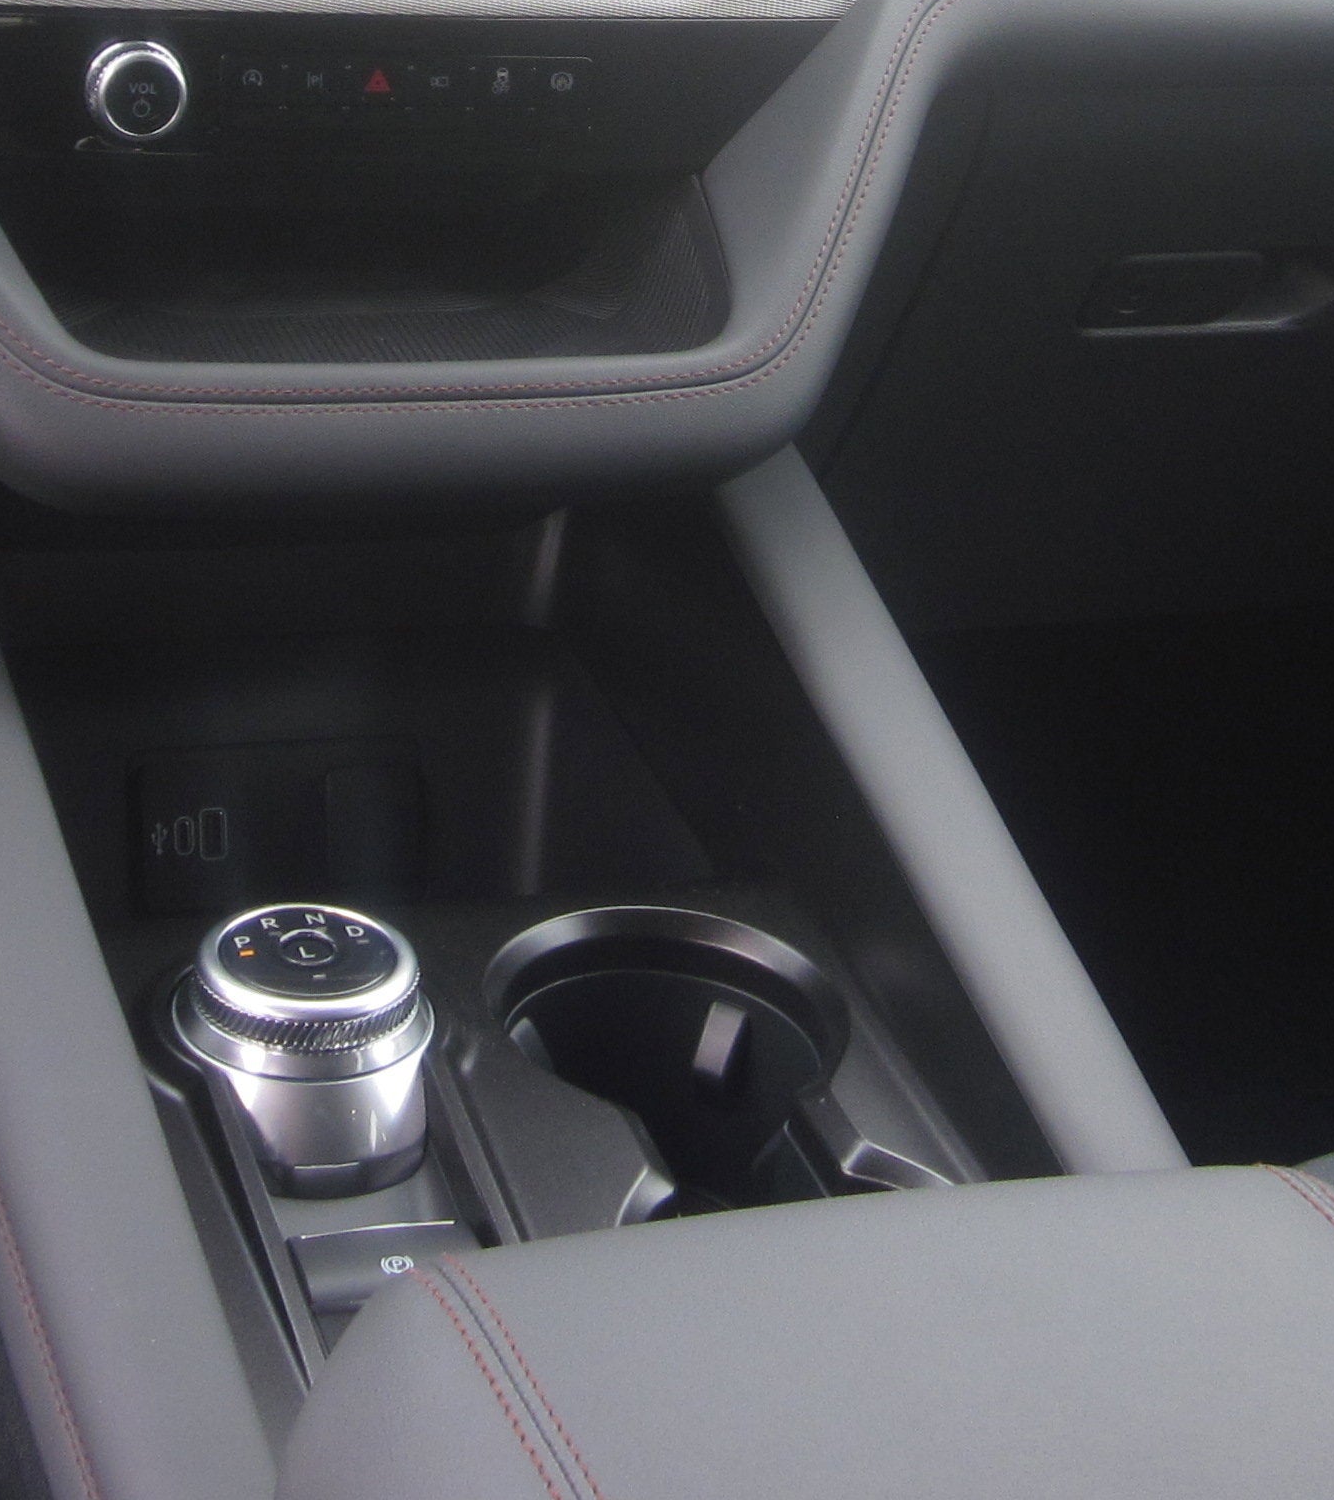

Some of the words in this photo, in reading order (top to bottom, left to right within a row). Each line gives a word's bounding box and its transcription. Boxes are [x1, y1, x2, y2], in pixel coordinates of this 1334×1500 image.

[128, 82, 157, 96] VOL
[260, 917, 279, 930] R
[305, 913, 327, 925] N
[345, 926, 364, 938] D
[233, 935, 251, 949] P
[298, 946, 316, 959] L
